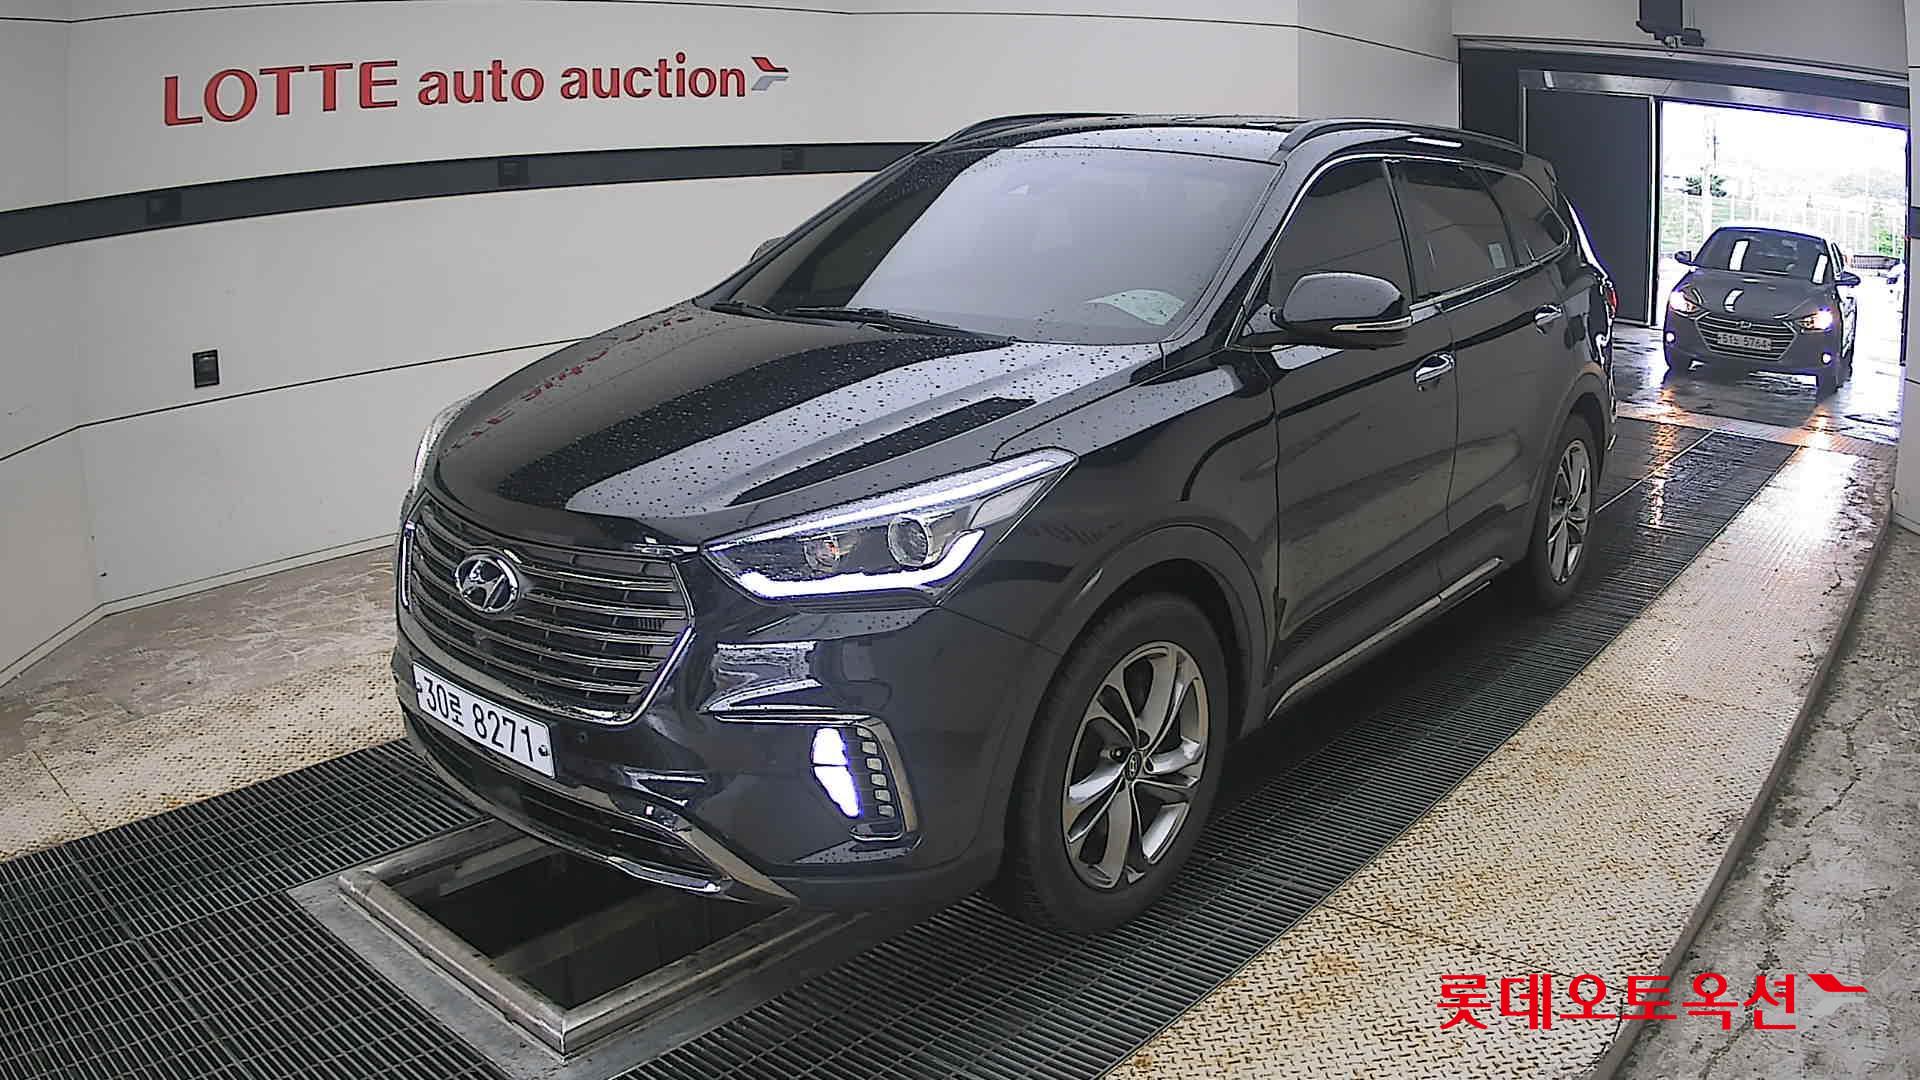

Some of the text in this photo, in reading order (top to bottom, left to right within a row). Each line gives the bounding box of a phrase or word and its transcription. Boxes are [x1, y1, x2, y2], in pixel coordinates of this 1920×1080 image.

[163, 52, 747, 126] LOTTE auto auction
[423, 676, 533, 762] 30로 8271
